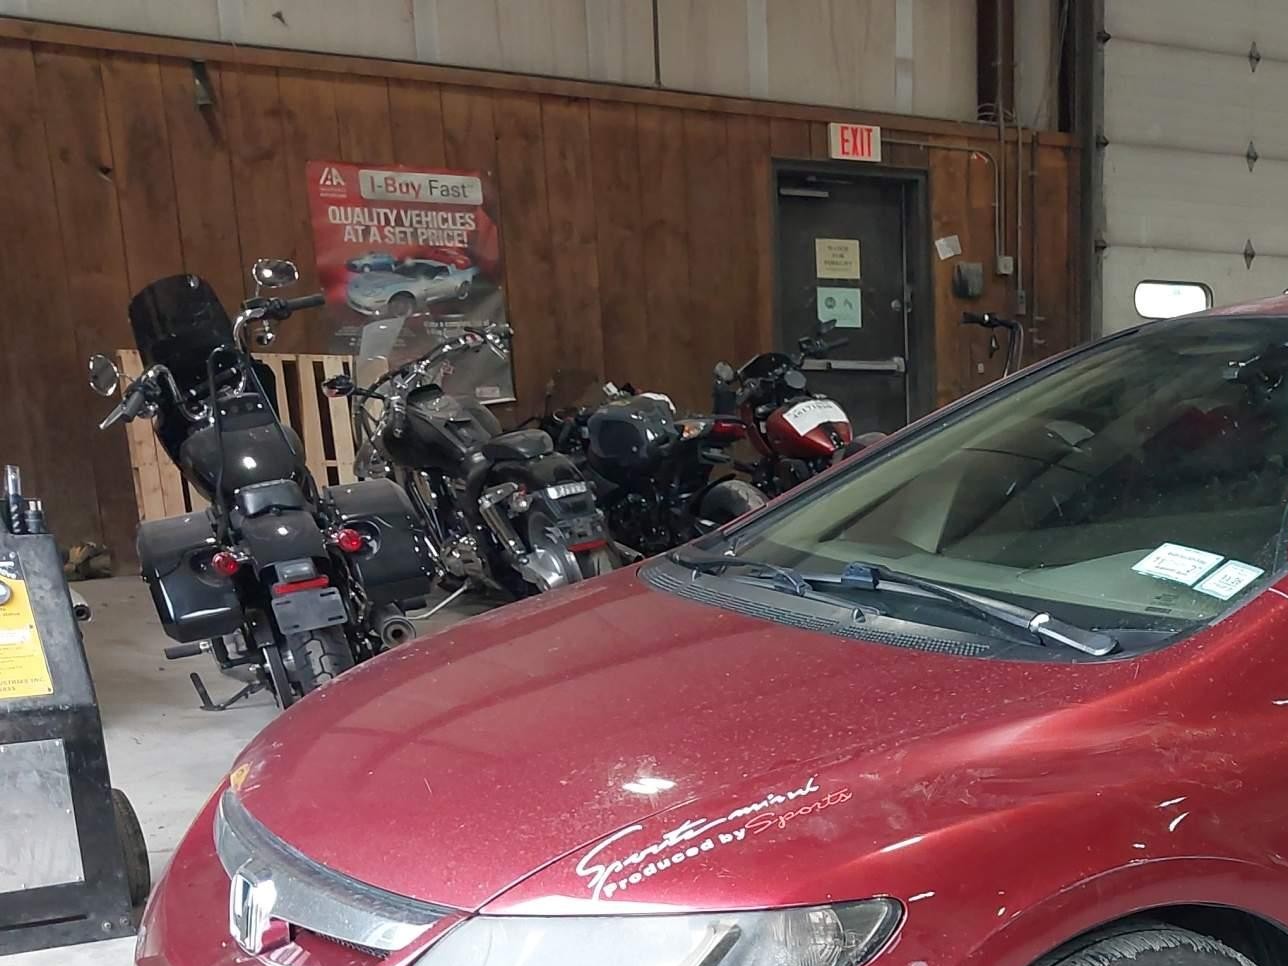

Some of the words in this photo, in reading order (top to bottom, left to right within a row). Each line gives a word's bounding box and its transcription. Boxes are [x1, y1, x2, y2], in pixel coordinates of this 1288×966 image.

[839, 125, 873, 158] EXIT
[370, 176, 421, 198] I-Buy
[428, 180, 469, 199] Fast
[328, 206, 398, 228] QUALITY
[400, 209, 476, 231] VEHICLES
[344, 225, 369, 243] AT
[369, 227, 383, 244] A
[385, 228, 413, 246] SET
[418, 230, 469, 249] PRICE!
[718, 827, 746, 845] by
[745, 788, 853, 836] Sports
